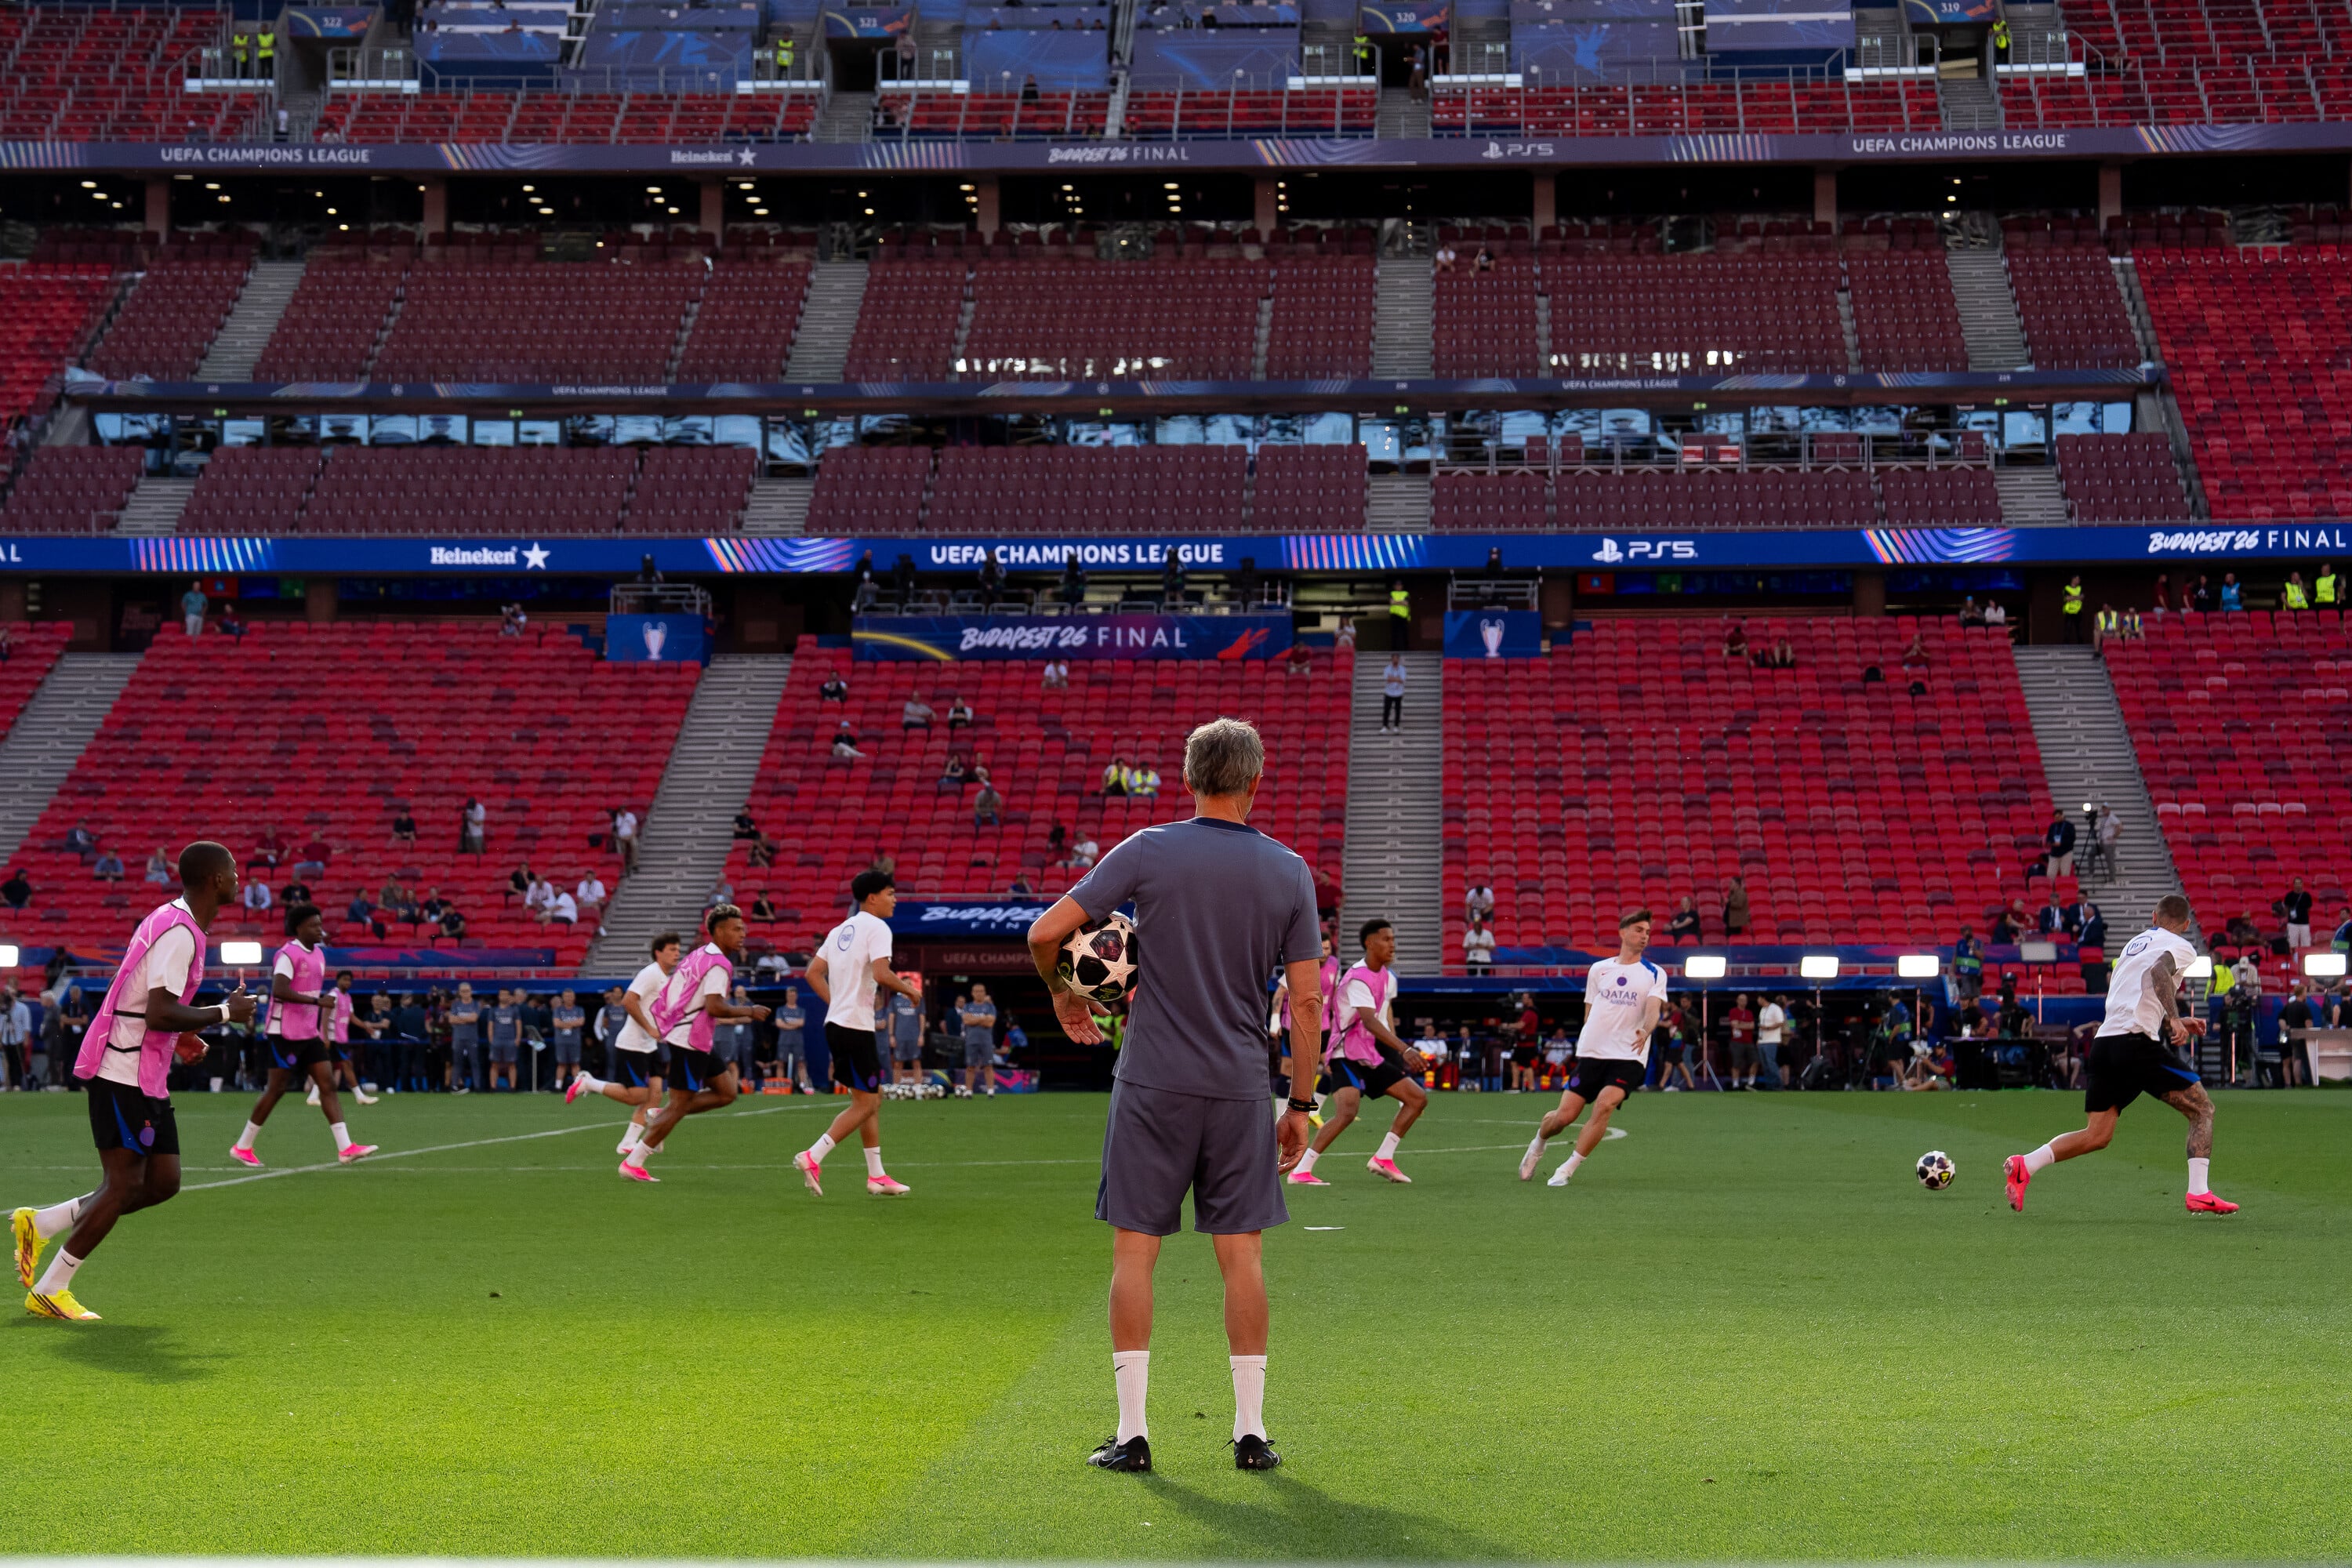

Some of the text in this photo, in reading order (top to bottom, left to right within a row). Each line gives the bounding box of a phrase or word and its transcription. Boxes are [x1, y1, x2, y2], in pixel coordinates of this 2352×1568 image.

[1941, 2, 1960, 13] 319
[1507, 143, 1554, 156] PS5
[1853, 134, 2066, 152] UEFA CHAMPIONS LEAGUE
[161, 147, 371, 163] UEFA CHAMPIONS LEAGUE
[671, 150, 733, 163] Heineken
[1133, 147, 1189, 161] FINAL
[552, 386, 668, 395] UEFA CHAMPIONS LEAGUE
[1562, 379, 1679, 390] UEFA CHAMPIONS LEAGUE
[2148, 531, 2236, 553] BUDAPEST
[2267, 529, 2347, 549] FINAL
[430, 546, 517, 564] Heineken
[931, 545, 988, 564] UEFA
[994, 545, 1131, 564] CHAMPIONS
[1628, 541, 1696, 559] PS5
[960, 626, 1061, 651] BUDAPEST
[1098, 626, 1187, 648] FINAL
[920, 906, 1044, 922] BUDAPE
[971, 921, 1020, 930] FIN
[943, 953, 1034, 964] UEFA CHAMPI
[1600, 989, 1638, 1000] QATAR
